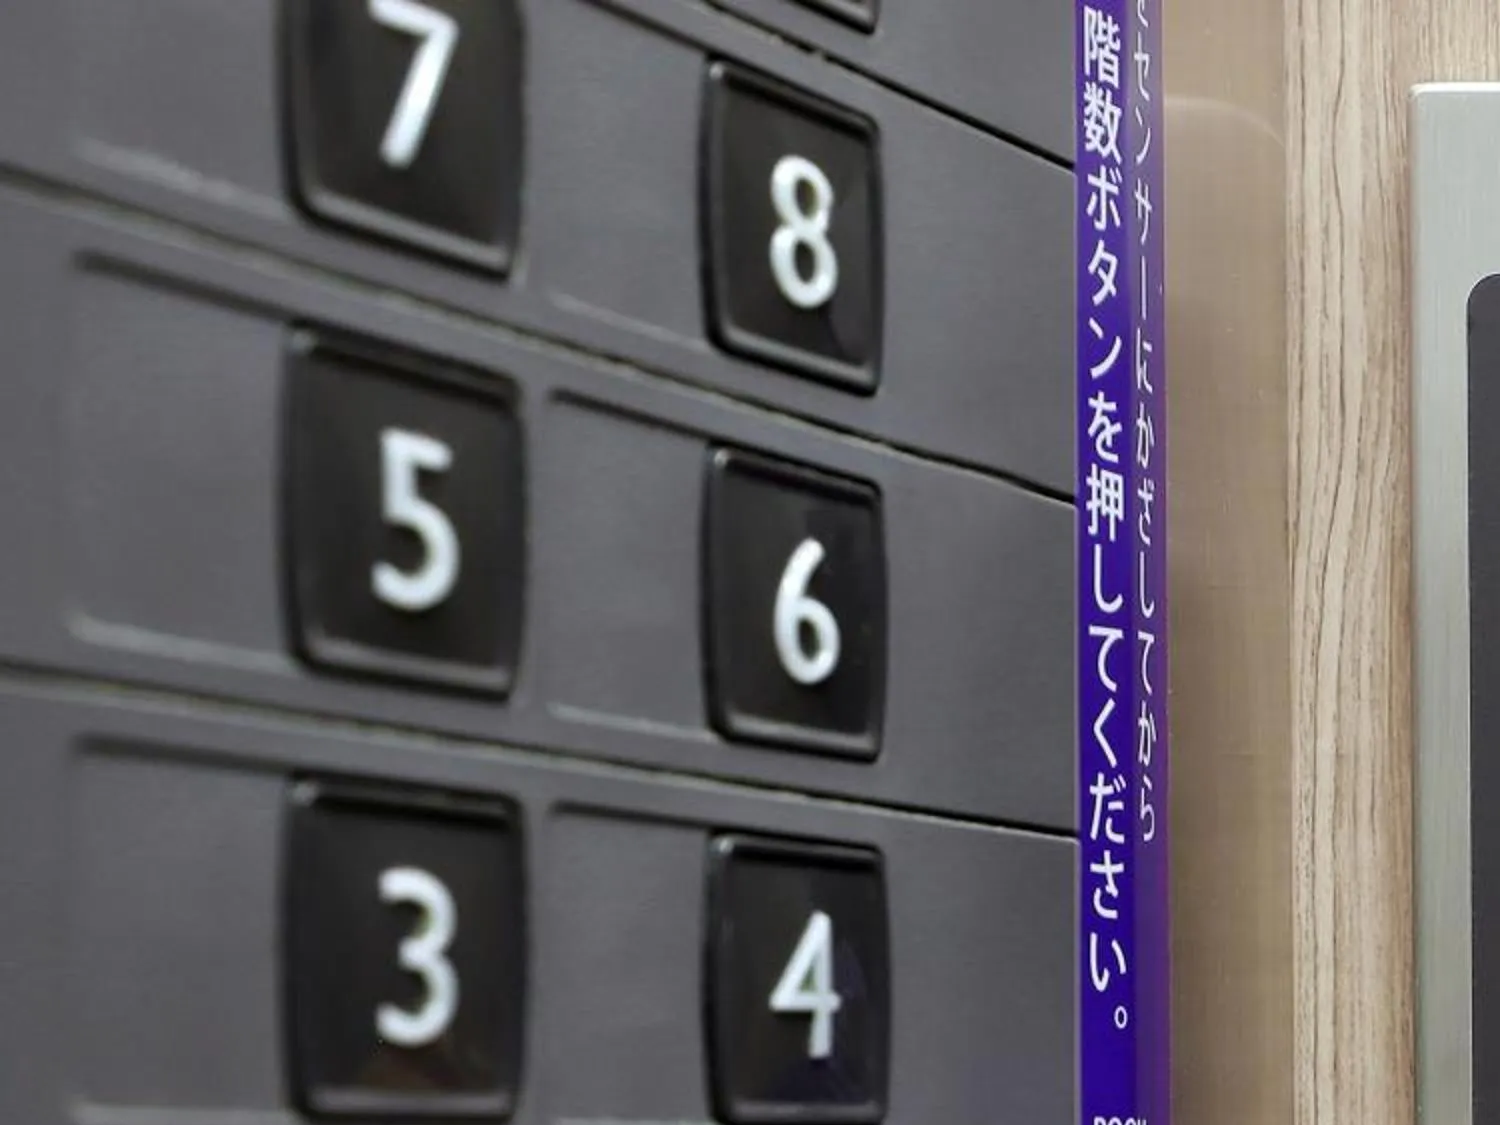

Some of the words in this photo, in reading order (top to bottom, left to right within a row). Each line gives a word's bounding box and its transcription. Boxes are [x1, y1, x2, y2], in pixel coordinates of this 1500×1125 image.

[368, 0, 460, 168] 7
[769, 154, 838, 309] 8
[372, 427, 460, 611] 5
[1082, 5, 1129, 1030] 階数ボタンを押してください。
[773, 538, 840, 685] 6
[376, 866, 457, 1046] 3
[769, 911, 841, 1058] 4
